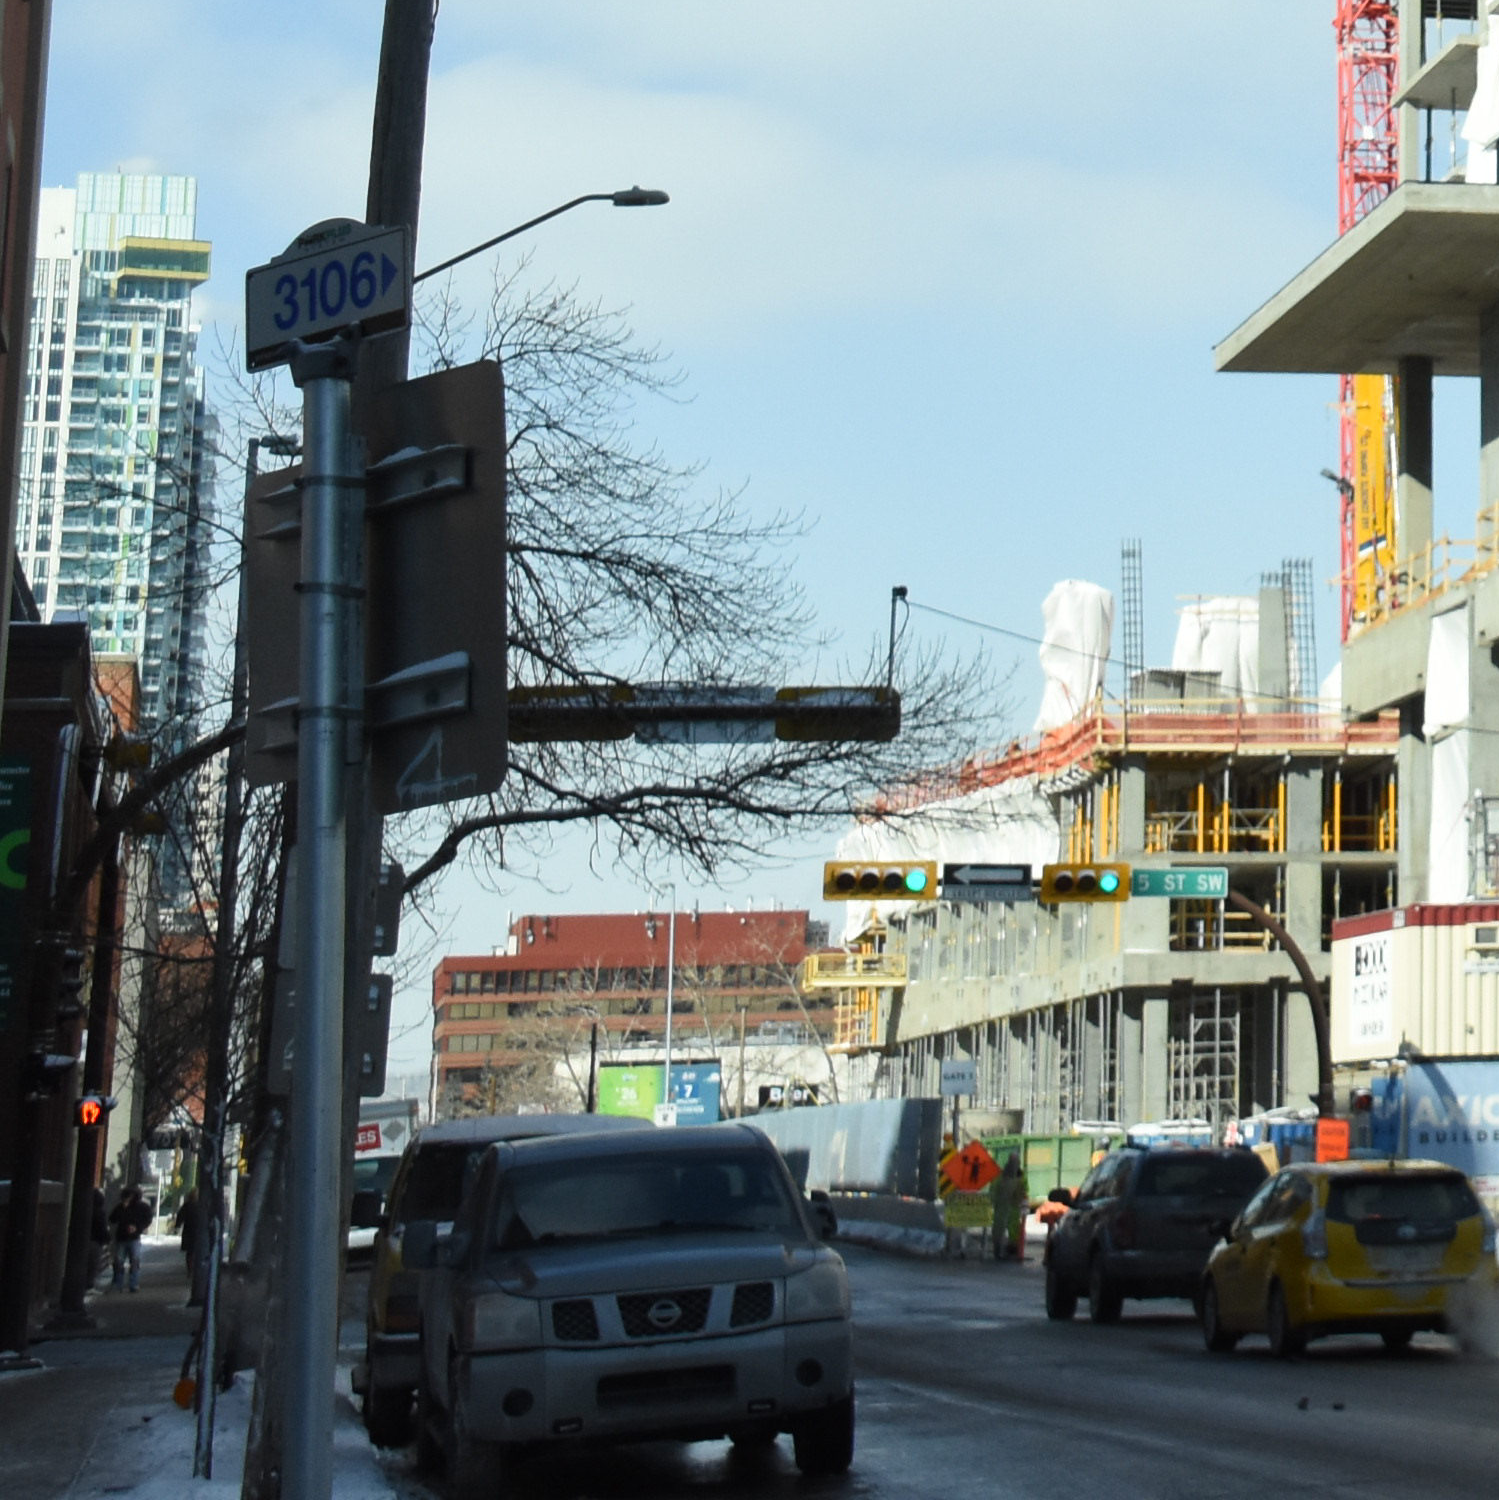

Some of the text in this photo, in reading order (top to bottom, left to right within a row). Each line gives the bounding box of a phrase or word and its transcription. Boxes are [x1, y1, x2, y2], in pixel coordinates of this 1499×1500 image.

[273, 251, 377, 331] 3106
[1138, 876, 1223, 890] 5 ST SW
[769, 1087, 809, 1102] Ber
